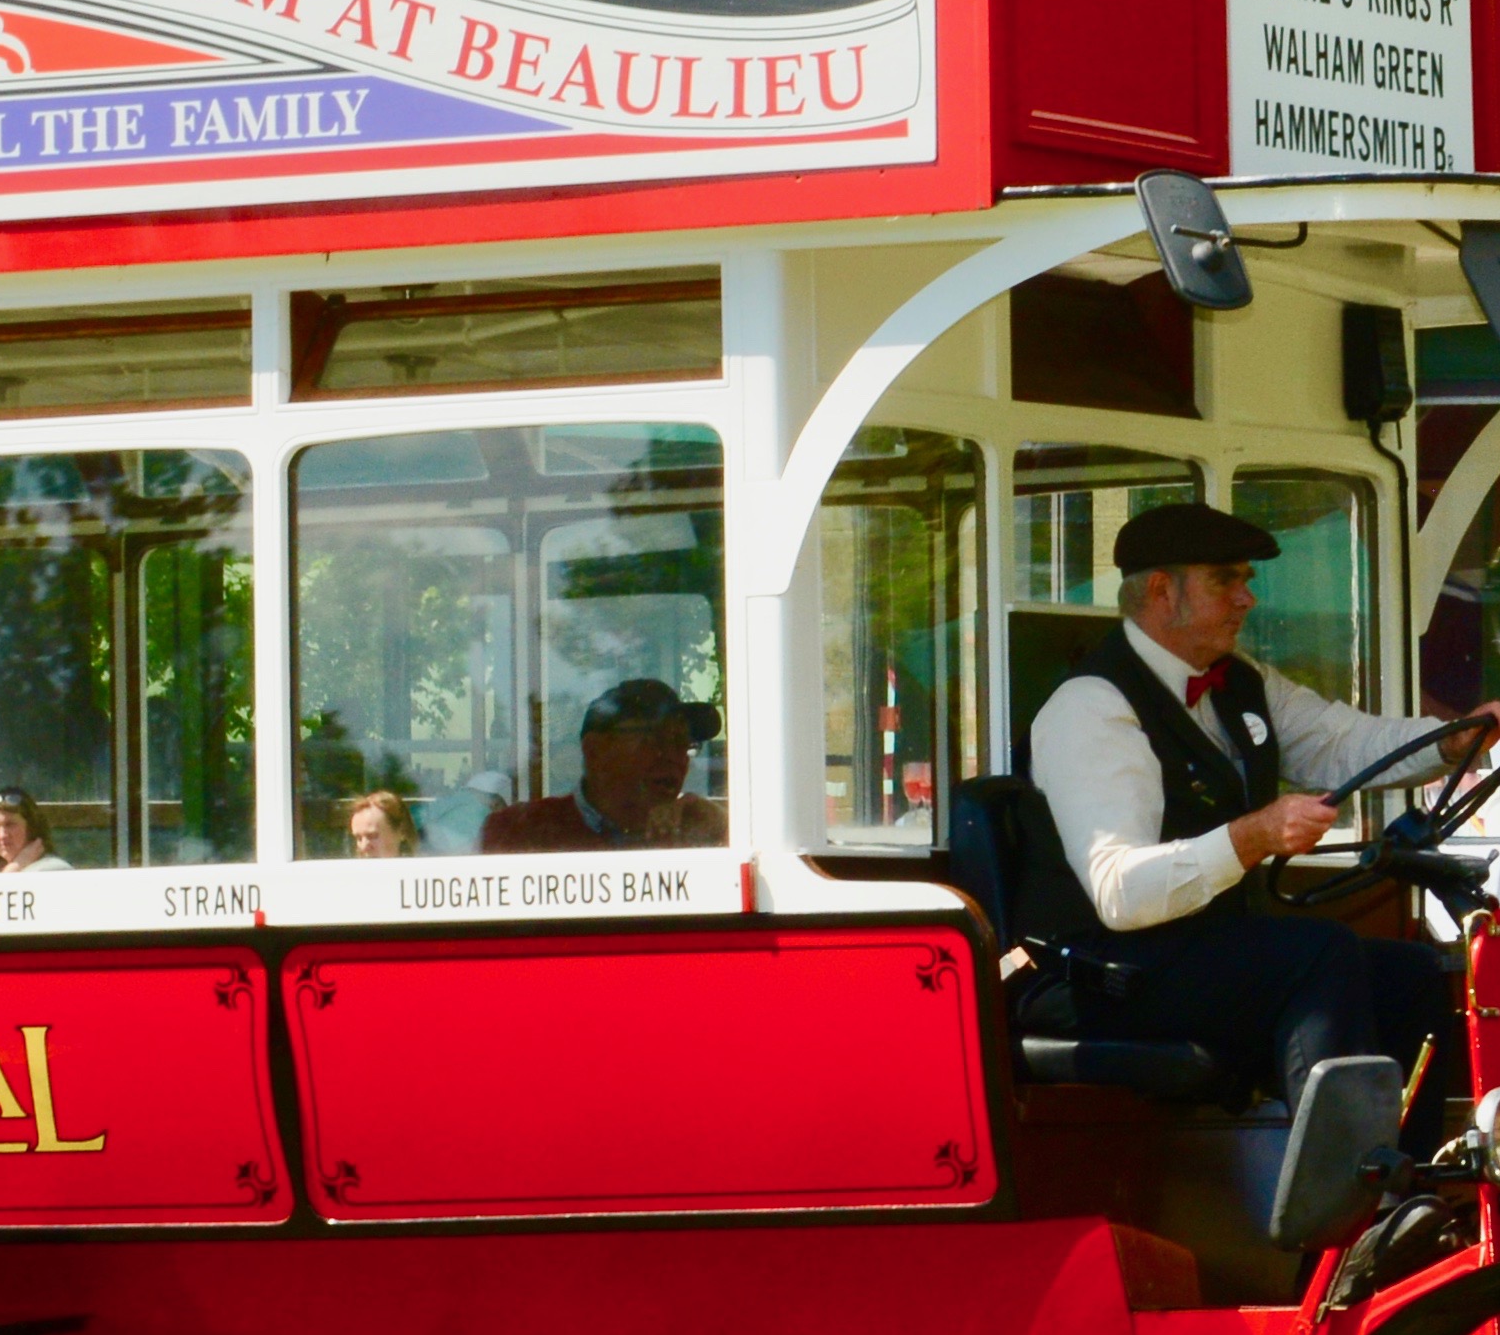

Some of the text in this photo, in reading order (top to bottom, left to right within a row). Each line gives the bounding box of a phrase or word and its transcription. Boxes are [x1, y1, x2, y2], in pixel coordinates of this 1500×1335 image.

[449, 16, 868, 119] BEAULIEU
[1264, 23, 1443, 98] WALHAM GREEN
[31, 103, 145, 155] THE
[170, 88, 369, 148] FAMILY
[1256, 99, 1425, 169] HAMMERSMITH
[164, 884, 260, 917] STRAND
[401, 870, 689, 910] LUDGATE CIRCUS BANK
